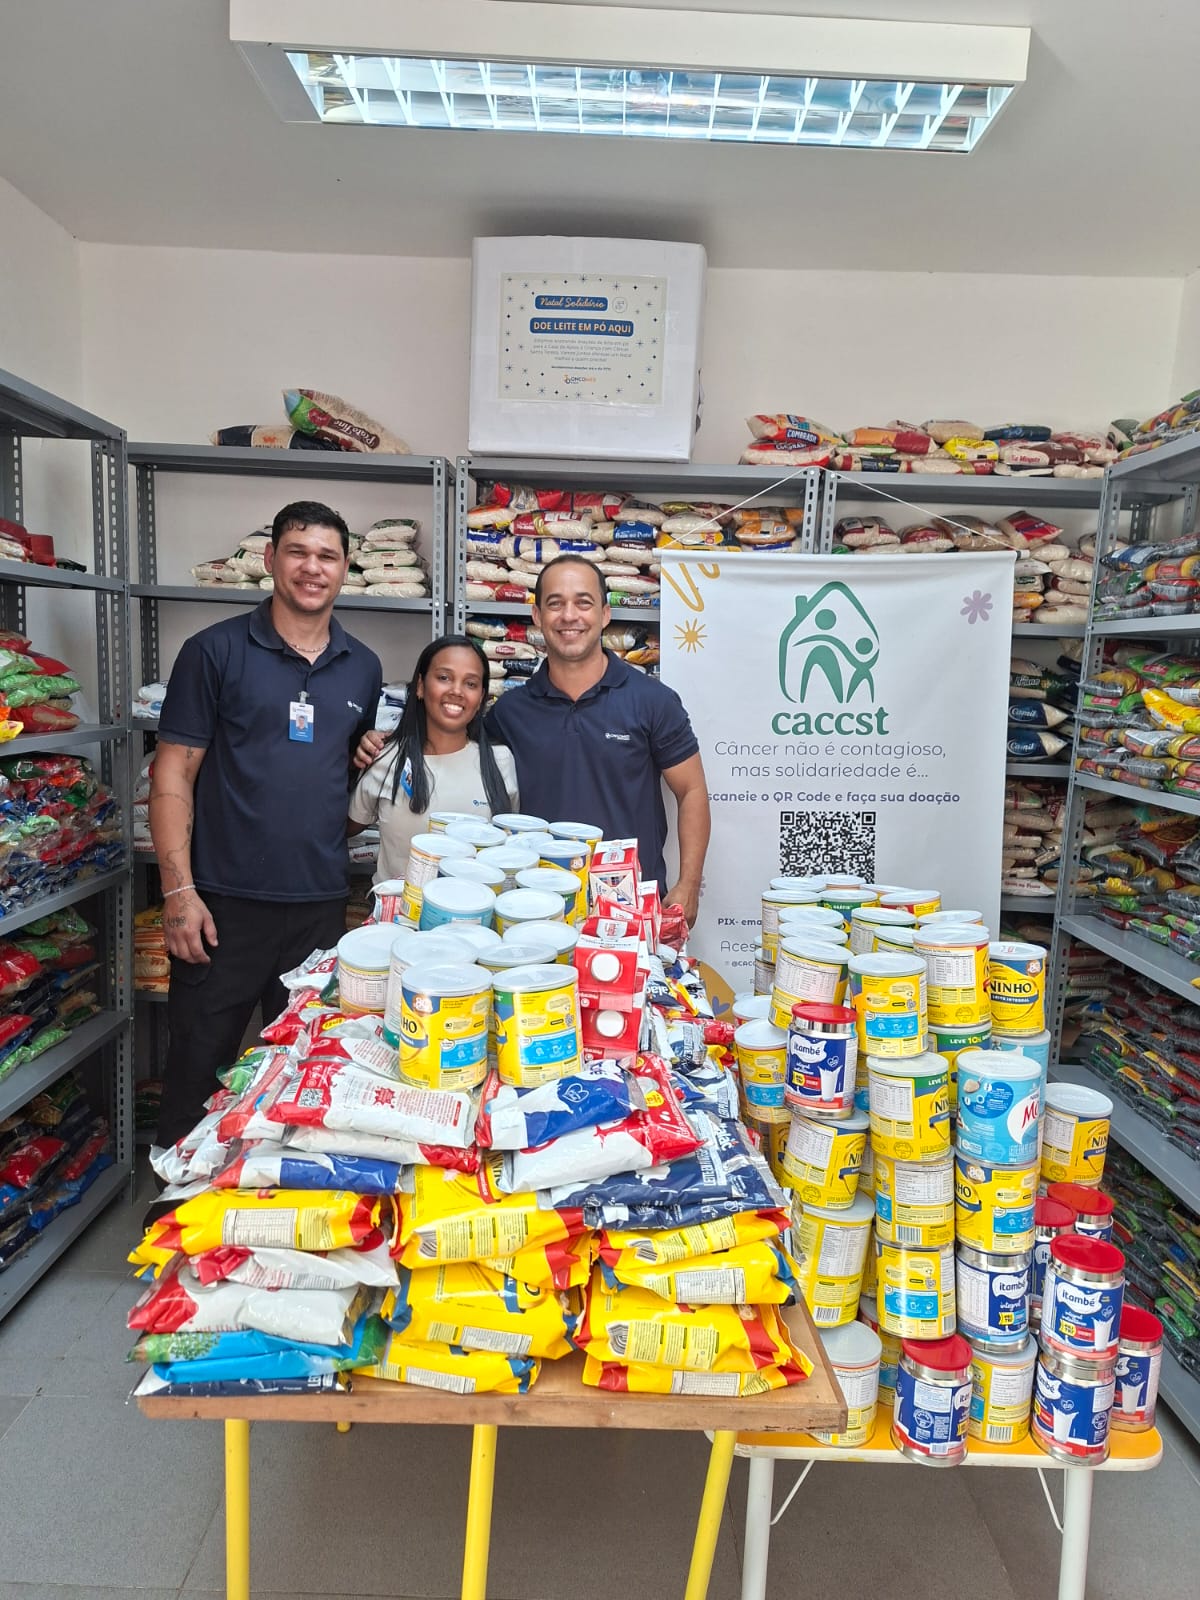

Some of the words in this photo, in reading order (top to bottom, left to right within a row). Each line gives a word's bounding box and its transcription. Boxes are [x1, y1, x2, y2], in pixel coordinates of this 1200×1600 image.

[540, 297, 564, 308] Natal
[534, 322, 552, 330] DOE
[554, 322, 576, 331] LEITE
[578, 323, 591, 332] EM
[594, 320, 606, 332] PÓ
[608, 324, 632, 335] AQUI
[1011, 707, 1036, 717] Camil
[771, 706, 890, 736] caccst
[714, 741, 780, 756] Câncer
[785, 742, 820, 756] não
[824, 742, 836, 756] é
[840, 742, 946, 760] contagioso,
[1010, 742, 1034, 751] Camil
[731, 766, 770, 778] mas
[776, 763, 900, 778] solidariedade
[906, 763, 928, 778] é...
[706, 790, 757, 802] scaneie
[760, 794, 770, 802] o
[773, 792, 793, 804] QR
[797, 791, 831, 802] Code
[834, 794, 843, 802] e
[846, 791, 876, 805] faça
[880, 794, 904, 802] sua
[908, 791, 960, 804] doação
[720, 940, 756, 952] Aces
[990, 980, 1032, 993] NINHO
[403, 1018, 418, 1033] HO
[794, 1042, 821, 1056] itambé
[957, 1184, 971, 1198] HO
[1062, 1289, 1095, 1307] itambé
